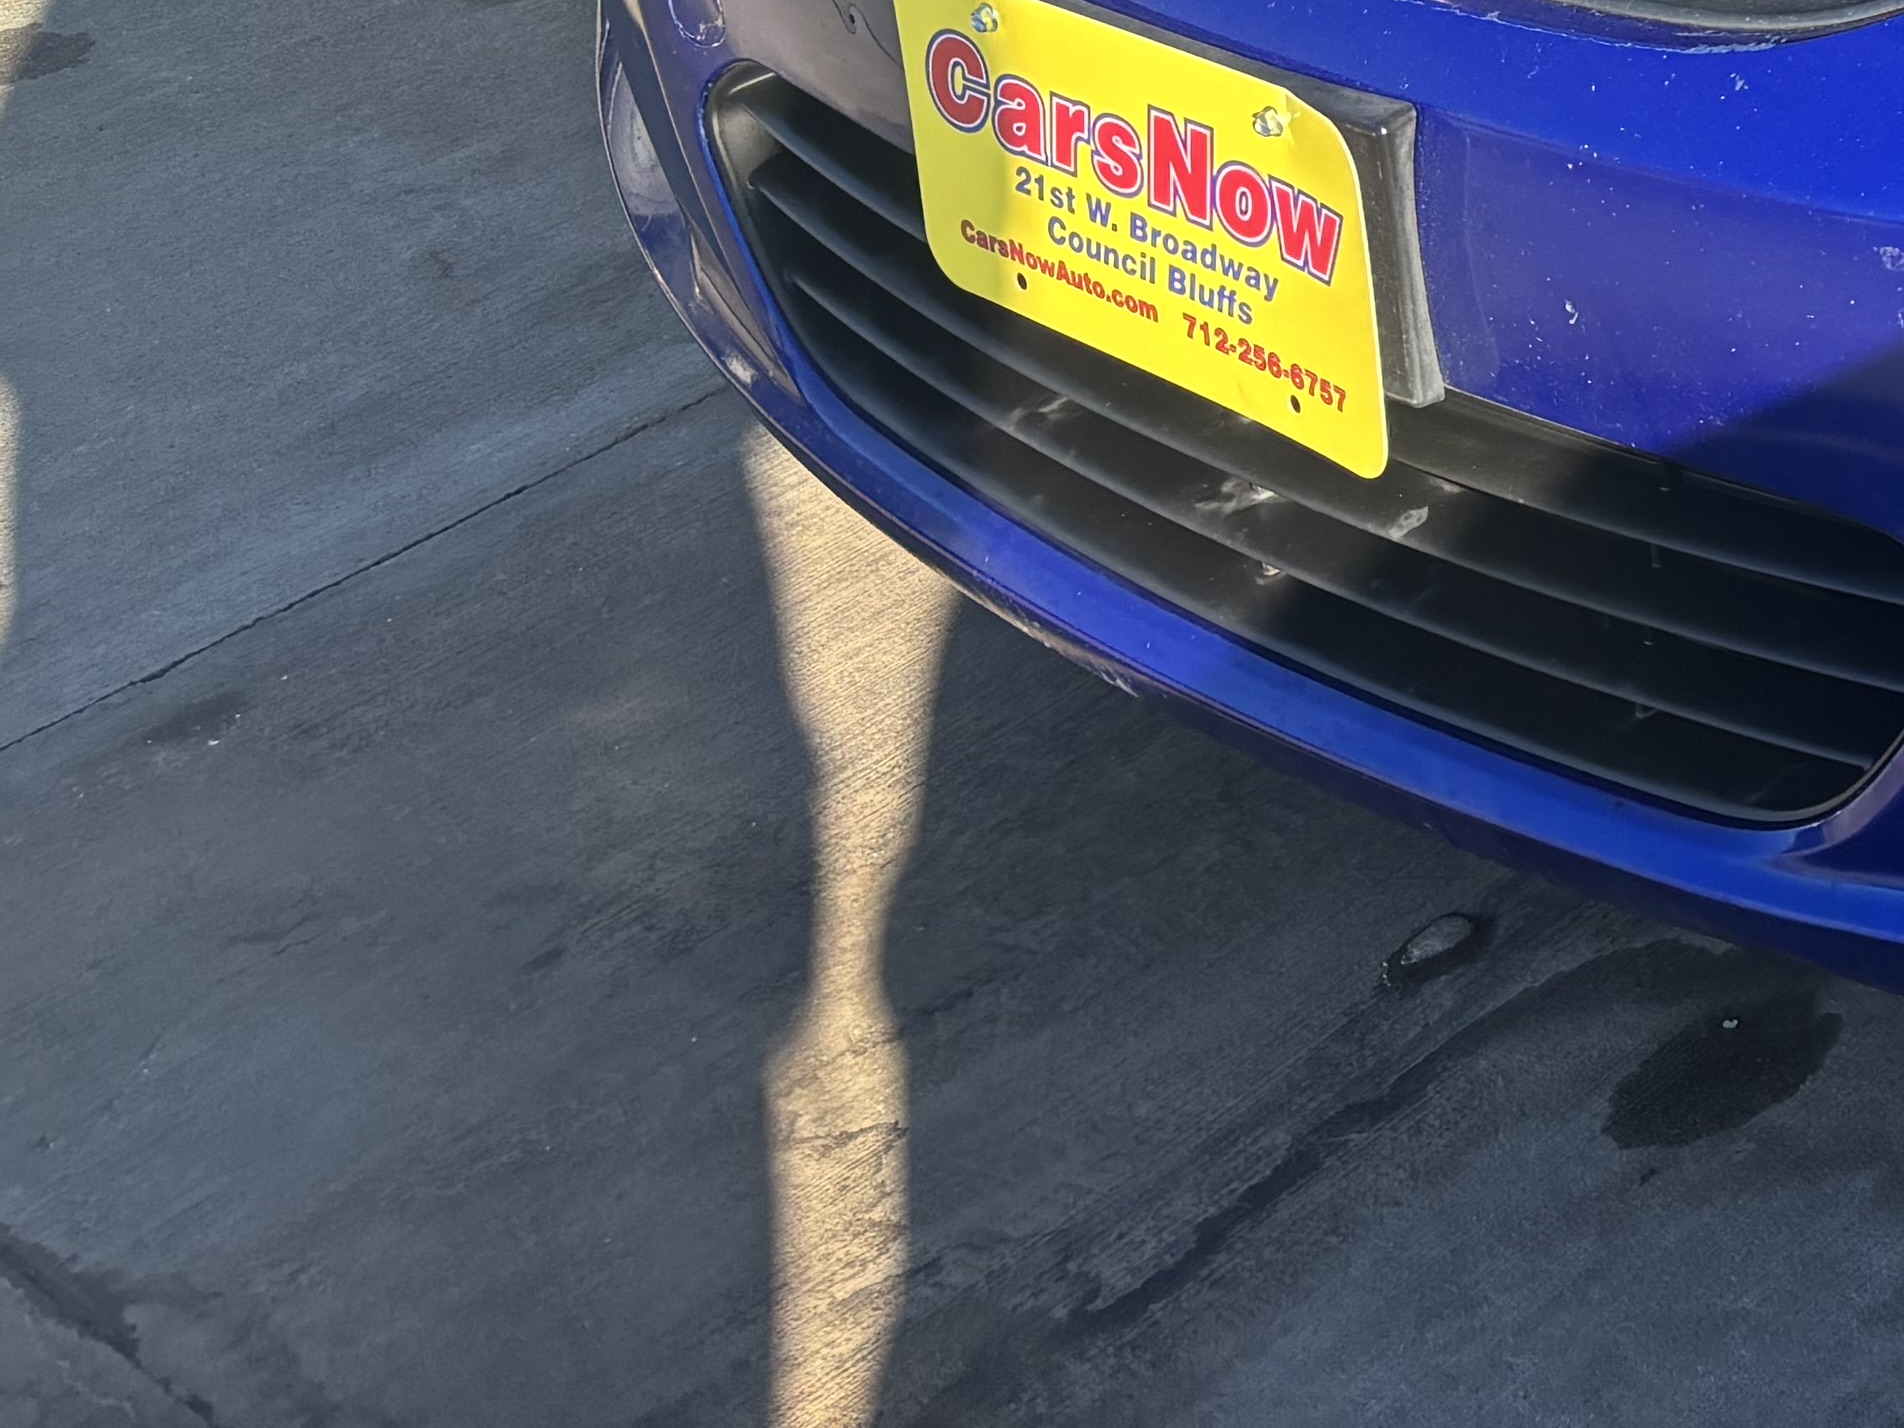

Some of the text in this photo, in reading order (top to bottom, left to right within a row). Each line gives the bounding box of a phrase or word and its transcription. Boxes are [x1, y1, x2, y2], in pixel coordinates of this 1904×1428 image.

[925, 29, 1343, 286] CarsNow
[1015, 166, 1279, 302] 21st W. Broadway
[960, 219, 1346, 413] CarsNowAuto.com 712-256-6757
[1047, 216, 1253, 325] Council Bluffs
